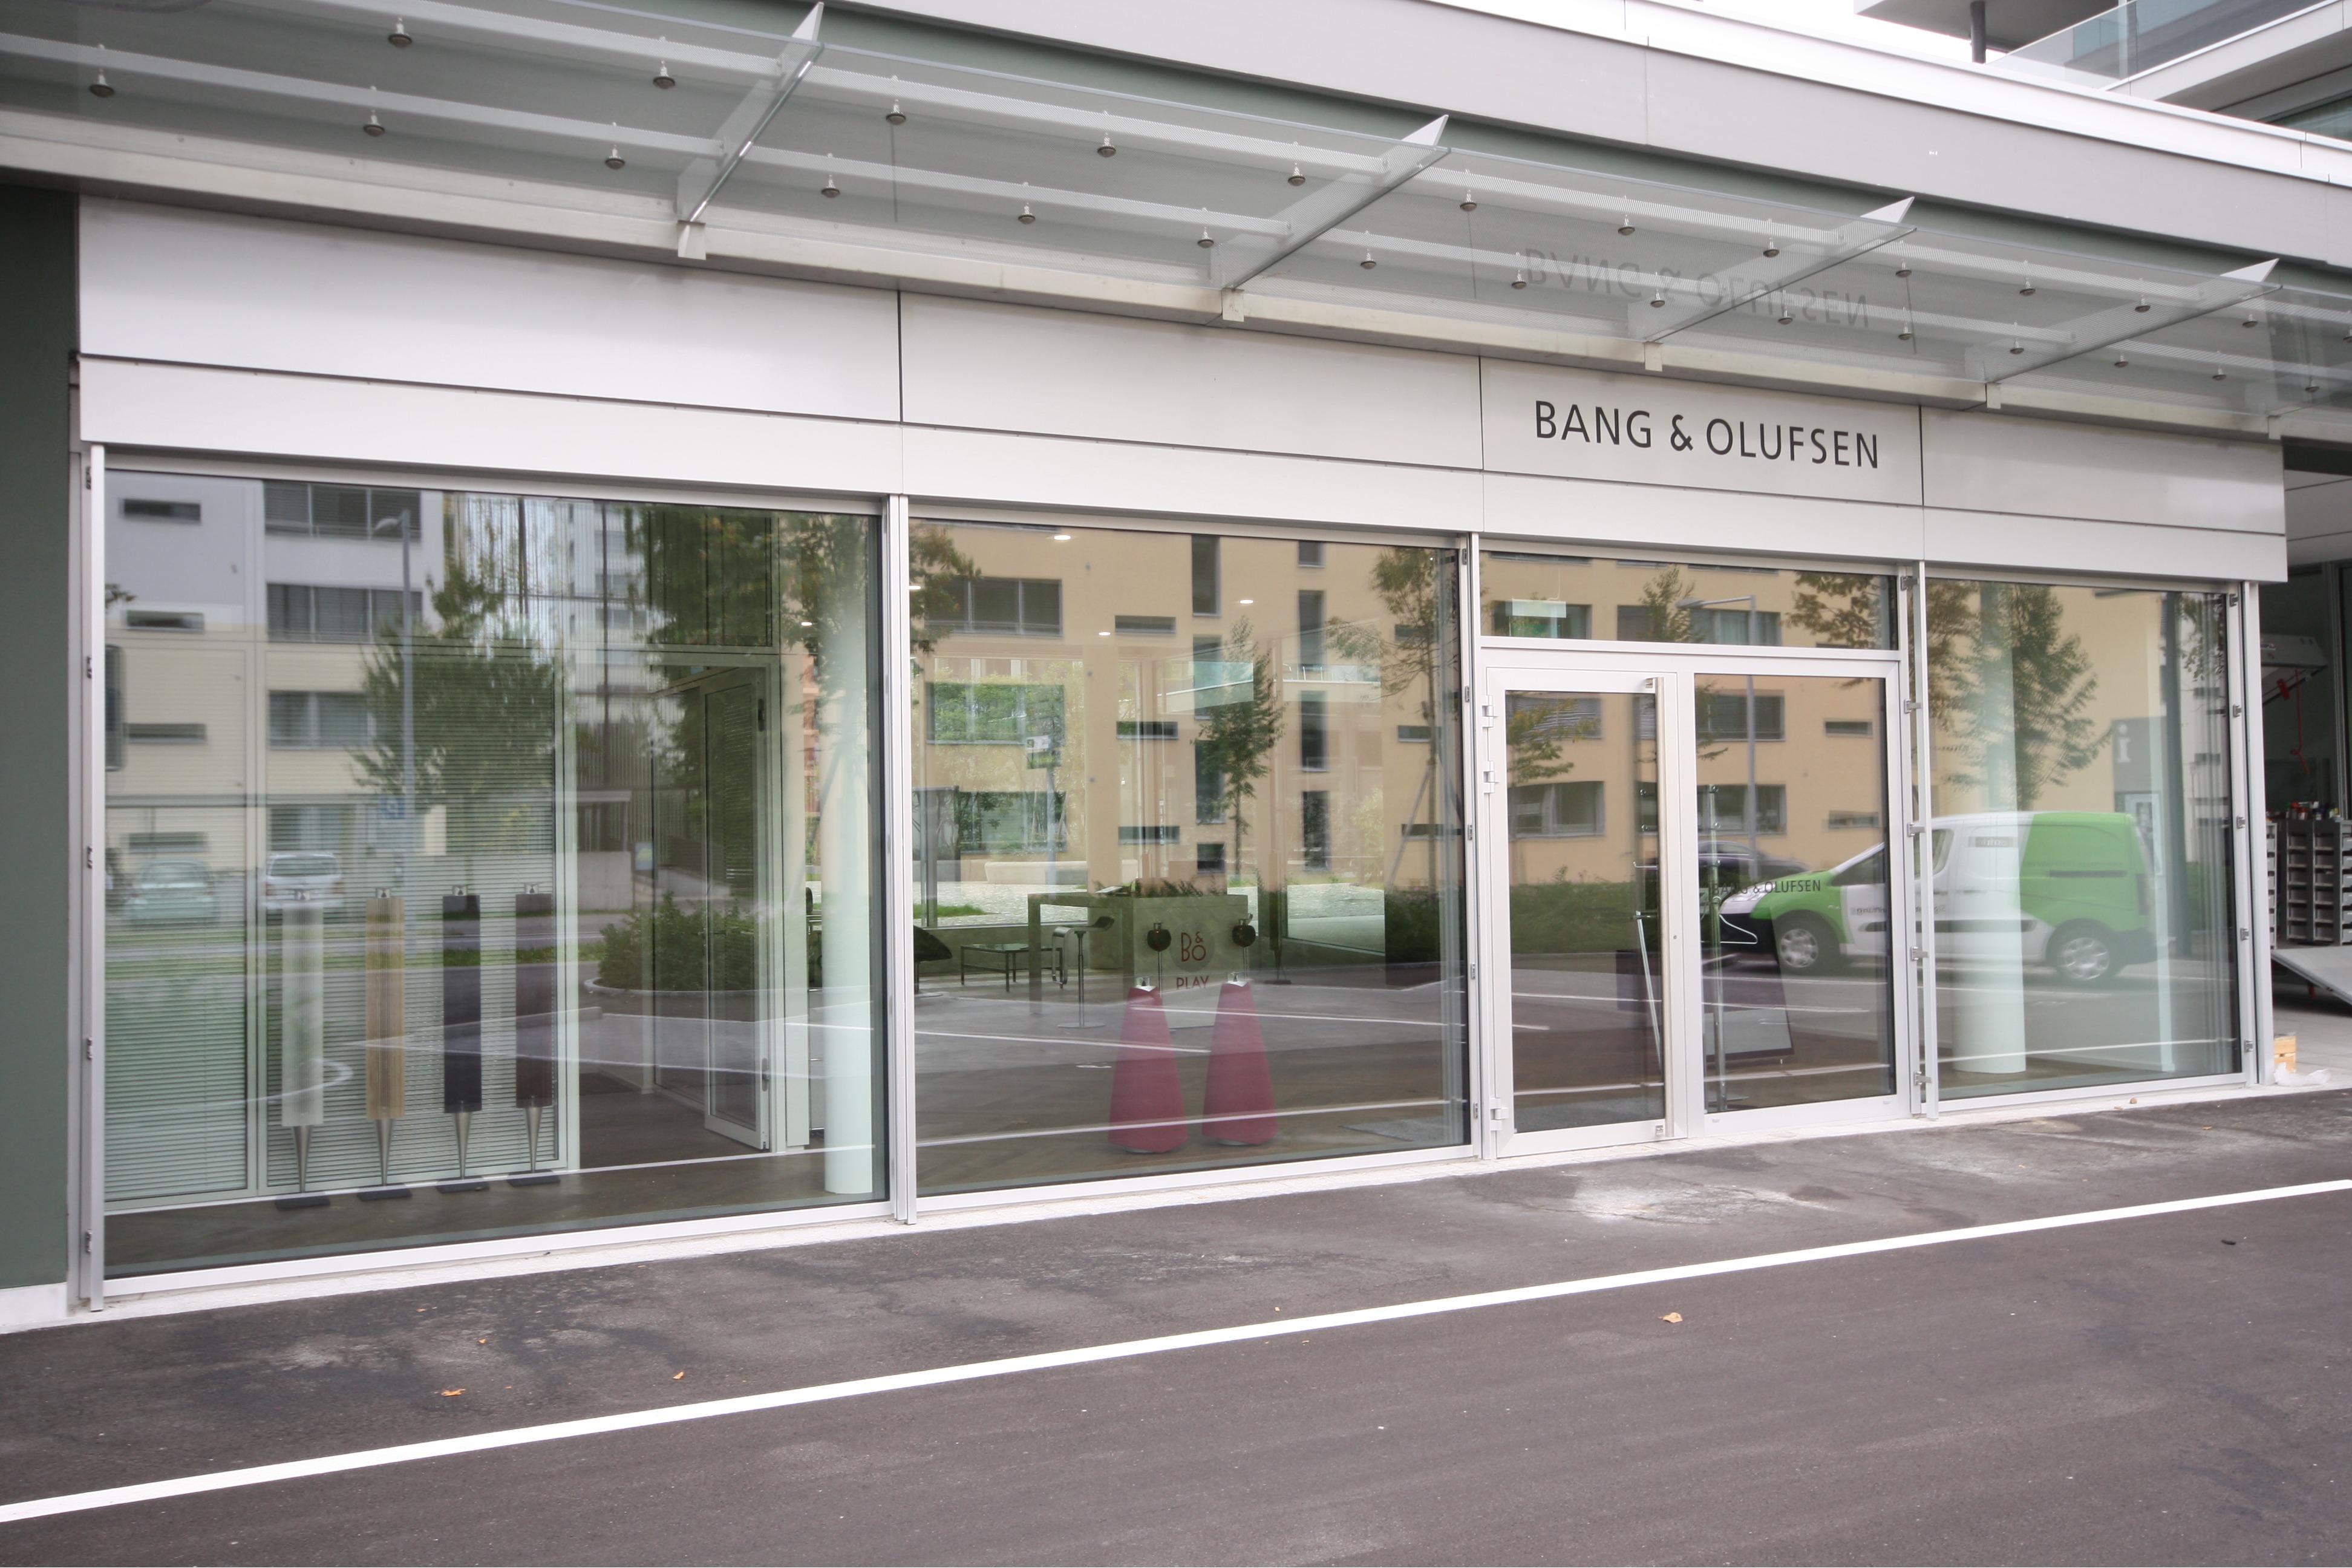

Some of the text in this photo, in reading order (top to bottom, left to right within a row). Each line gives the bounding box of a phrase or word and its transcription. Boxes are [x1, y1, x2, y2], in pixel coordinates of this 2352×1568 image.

[1535, 400, 1878, 469] BANG & OLUFSEN
[1764, 880, 1821, 893] OLUFSEN
[1176, 976, 1209, 990] PLAY
